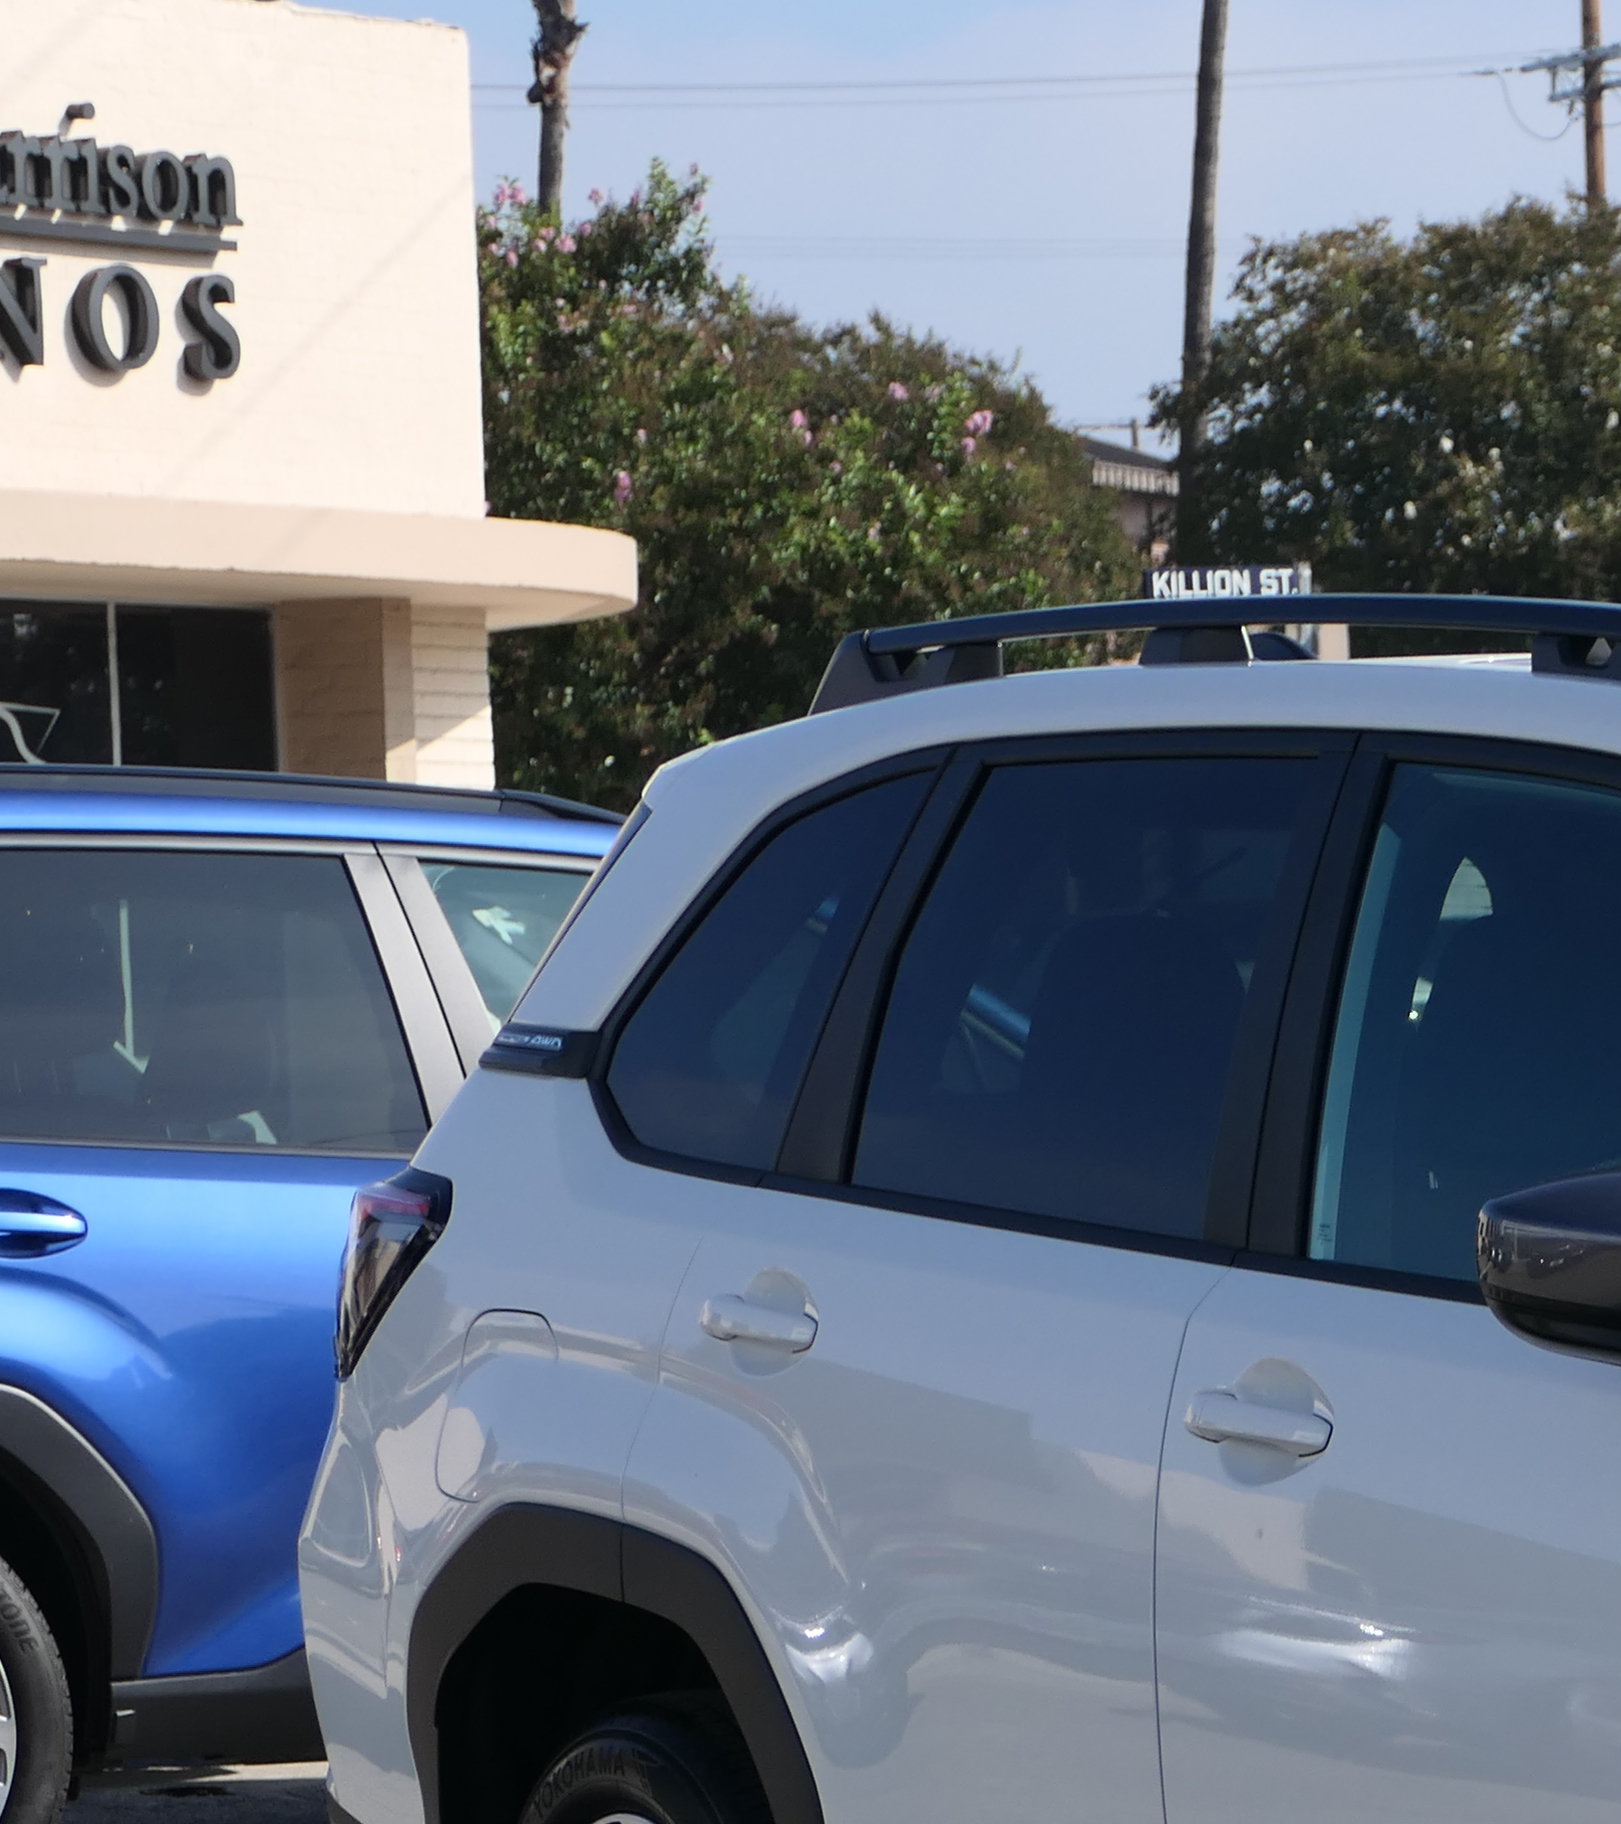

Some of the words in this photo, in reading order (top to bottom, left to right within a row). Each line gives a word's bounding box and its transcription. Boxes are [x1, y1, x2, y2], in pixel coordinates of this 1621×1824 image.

[1152, 569, 1251, 599] KILLION
[1259, 568, 1299, 596] ST.
[533, 1745, 626, 1819] YOKOHAMA
